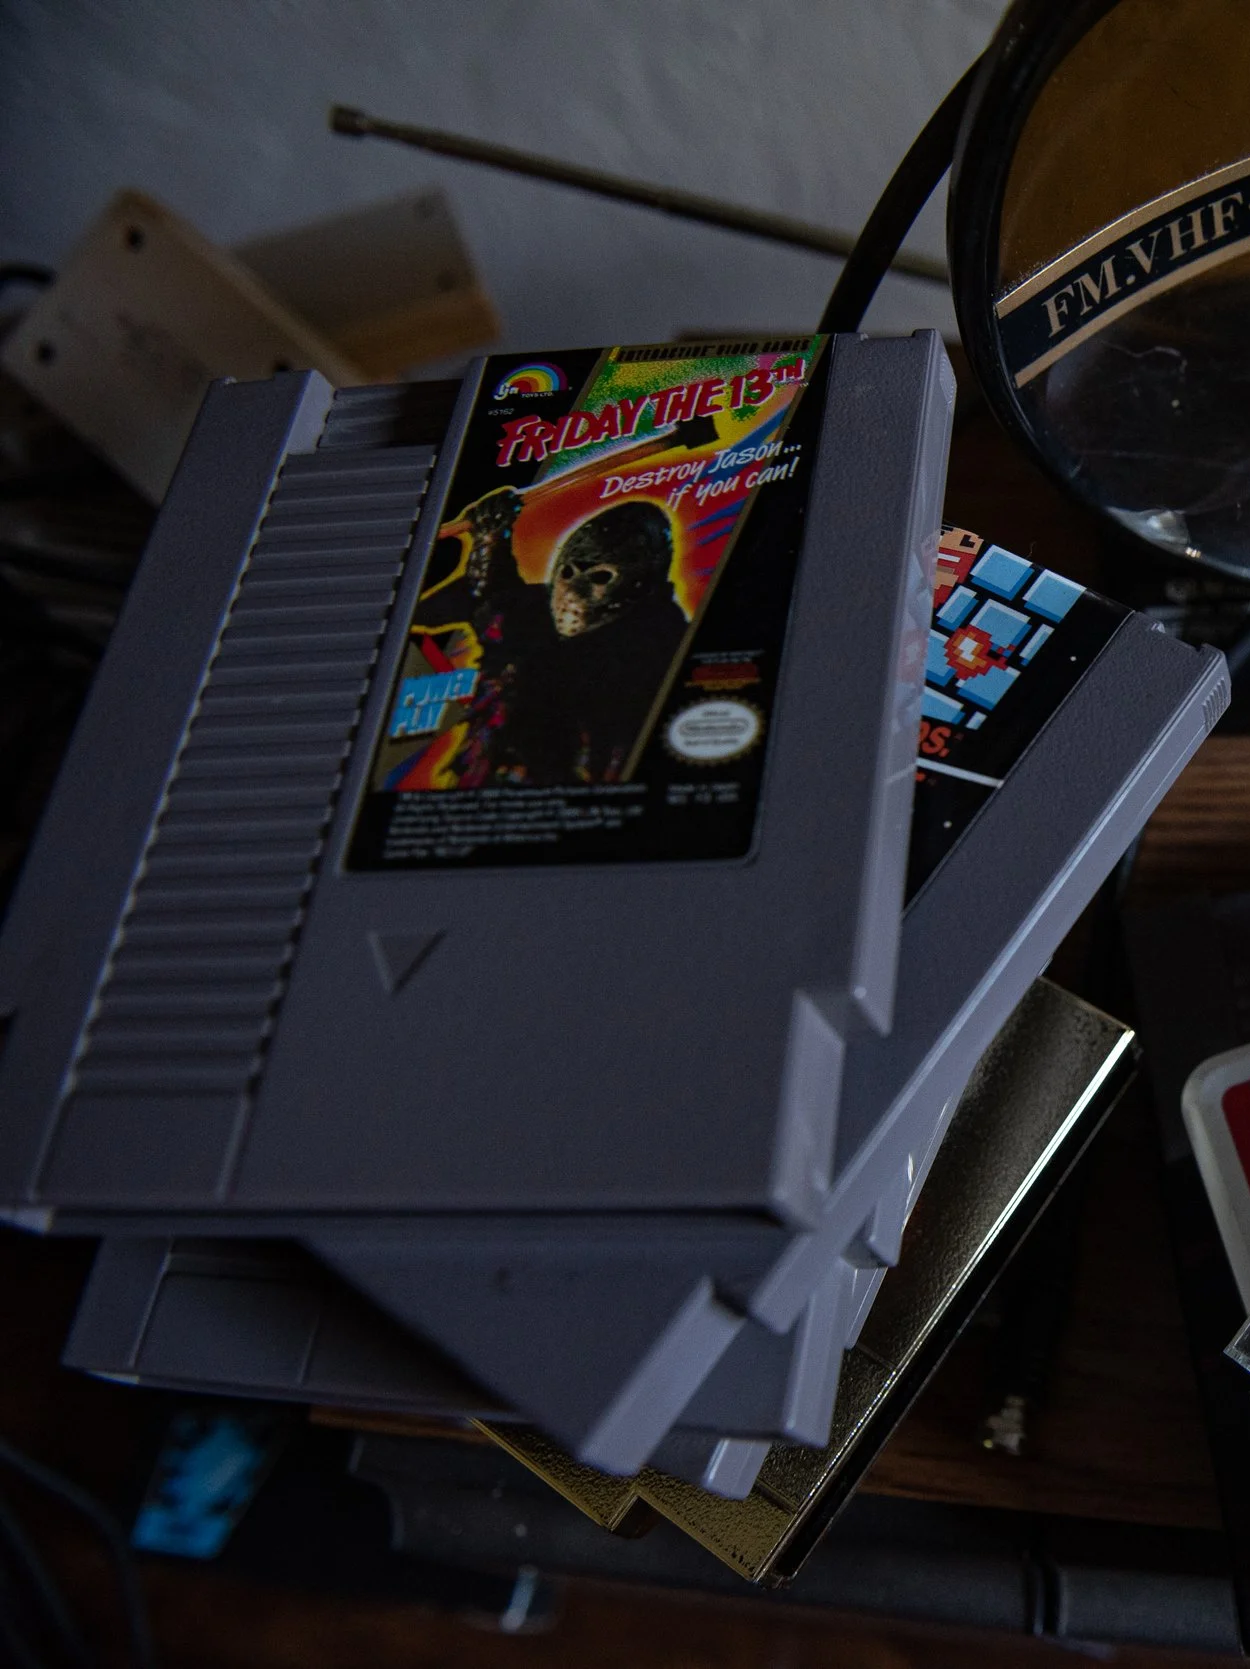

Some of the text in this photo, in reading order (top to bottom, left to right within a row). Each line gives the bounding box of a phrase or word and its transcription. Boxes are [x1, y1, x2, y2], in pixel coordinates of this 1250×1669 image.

[495, 395, 649, 469] FRIDAY
[645, 377, 729, 428] THE
[599, 457, 706, 501] Destroy
[694, 478, 738, 508] you
[743, 454, 801, 490] can!
